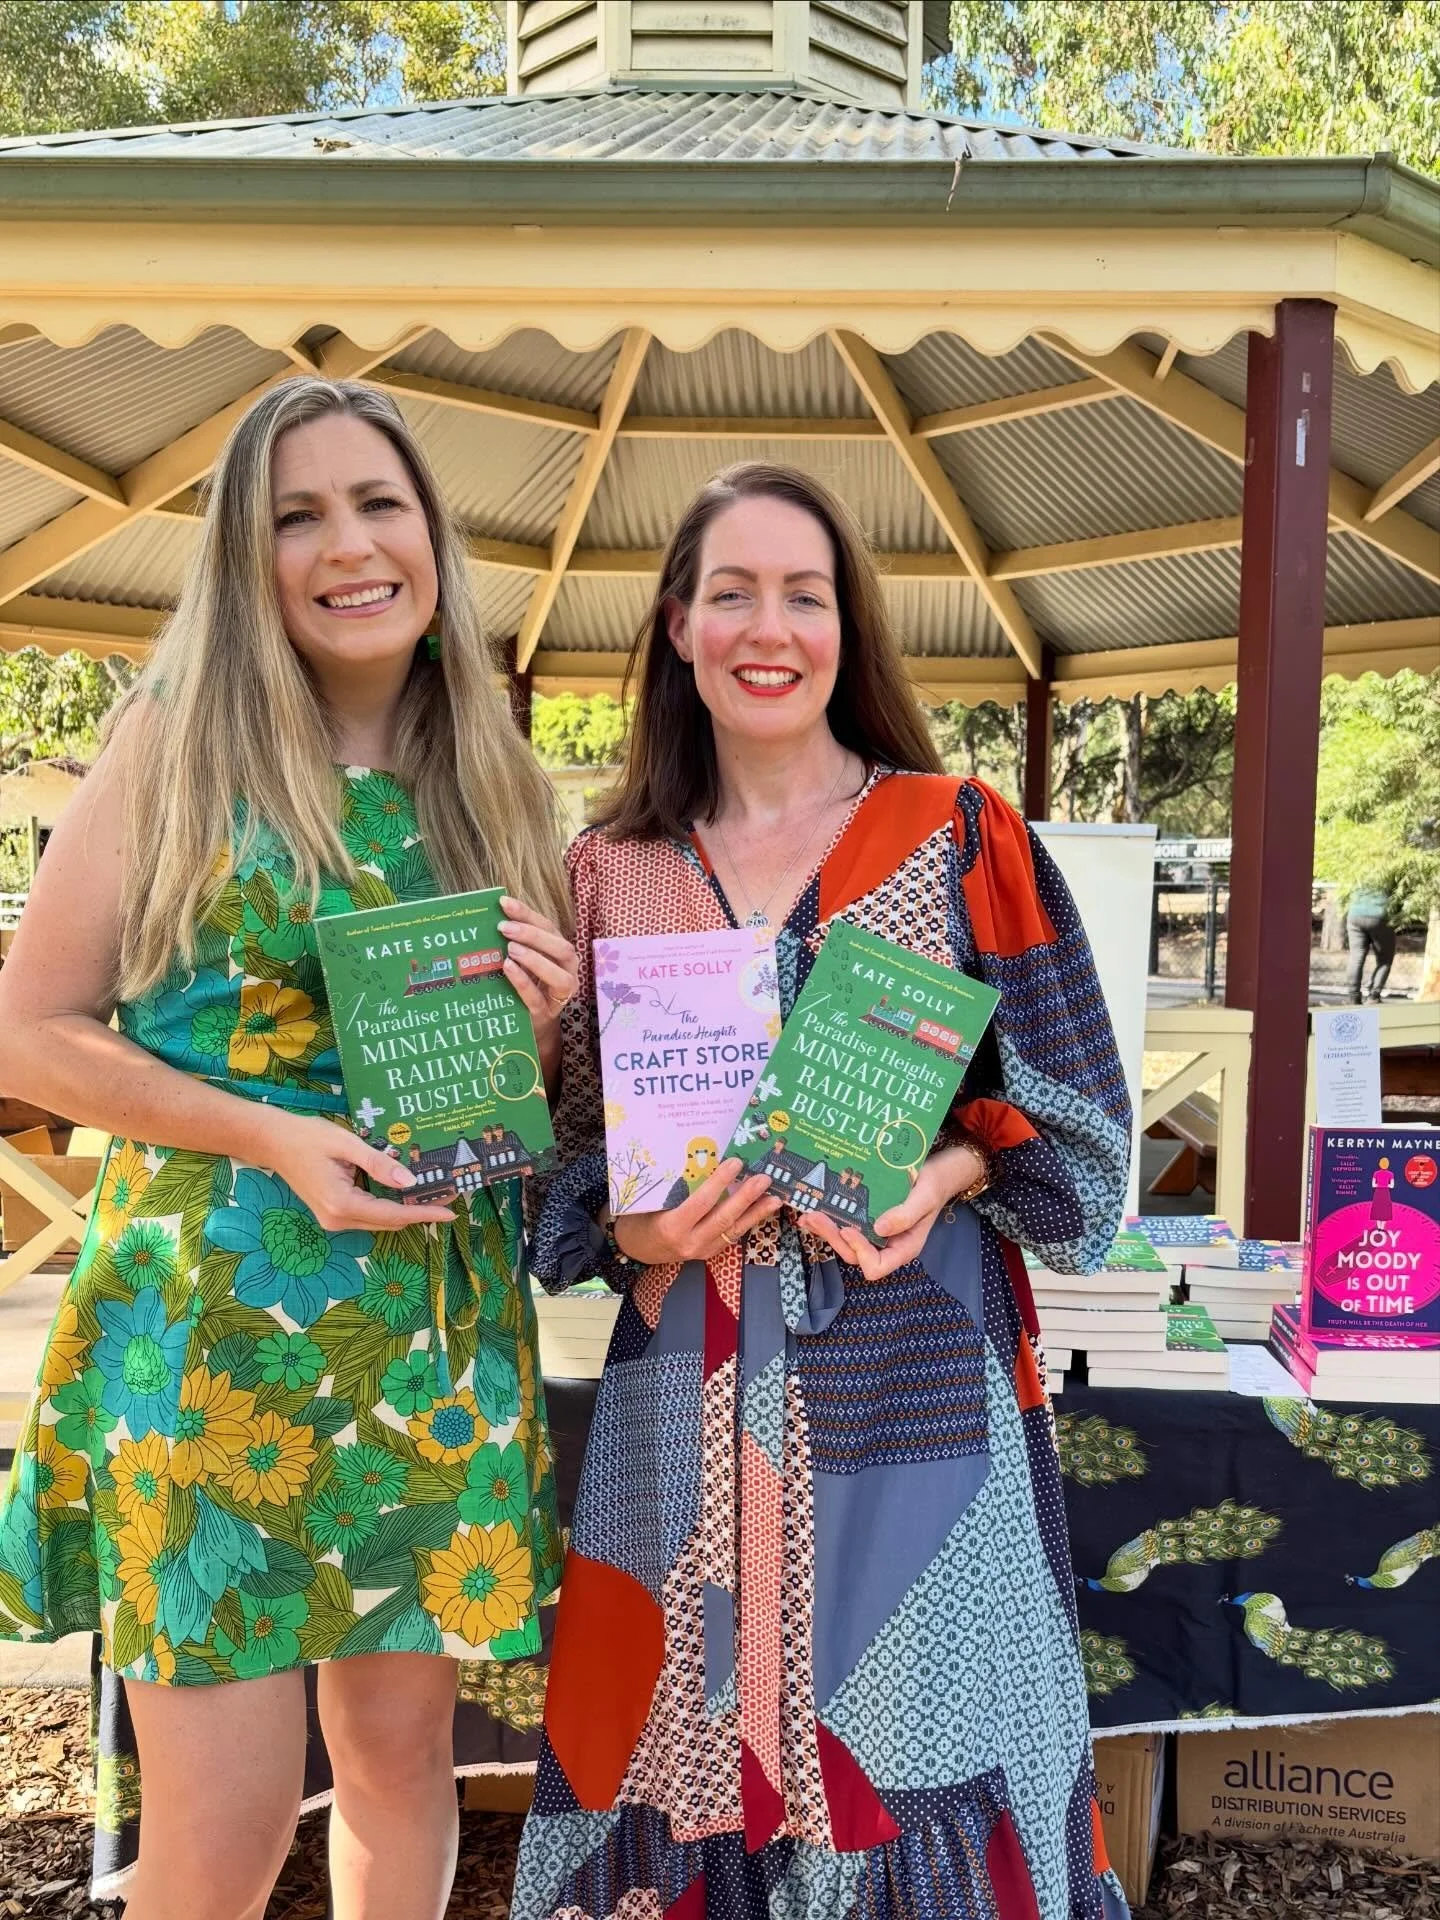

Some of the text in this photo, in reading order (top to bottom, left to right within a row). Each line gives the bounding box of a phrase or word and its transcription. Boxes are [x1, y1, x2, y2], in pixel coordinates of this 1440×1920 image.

[366, 927, 478, 960] KATE SOLLY
[638, 960, 733, 980] KATE SOLLY
[852, 962, 956, 1016] KATE SOLLY
[357, 993, 515, 1038] Paradise Heights
[377, 998, 399, 1017] The
[679, 1010, 700, 1024] The
[828, 1008, 849, 1028] The
[360, 1013, 520, 1066] MINIATURE
[642, 1024, 738, 1044] Paradise Heights
[614, 1041, 770, 1072] CRAFT STORE
[802, 1012, 946, 1090] Paradise Heights
[385, 1044, 507, 1090] RAILWAY
[791, 1033, 938, 1113] MINIATURE
[397, 1074, 506, 1118] BUST-UP
[633, 1069, 754, 1097] STITCH-UP
[796, 1066, 912, 1128] RAILWAY
[789, 1092, 894, 1150] BUST-UP
[1327, 1138, 1440, 1150] KERRYN MAYNE
[1358, 1230, 1401, 1248] JOY
[1337, 1251, 1422, 1270] MOODY
[1347, 1274, 1410, 1291] IS OUT
[1340, 1295, 1414, 1314] OF TIME
[1224, 1750, 1394, 1800] alliance
[1211, 1795, 1406, 1825] DISTRIBUTION SERVICES
[1211, 1816, 1221, 1826] A
[1224, 1816, 1271, 1830] division
[1274, 1820, 1287, 1832] of
[1349, 1828, 1406, 1843] Australia
